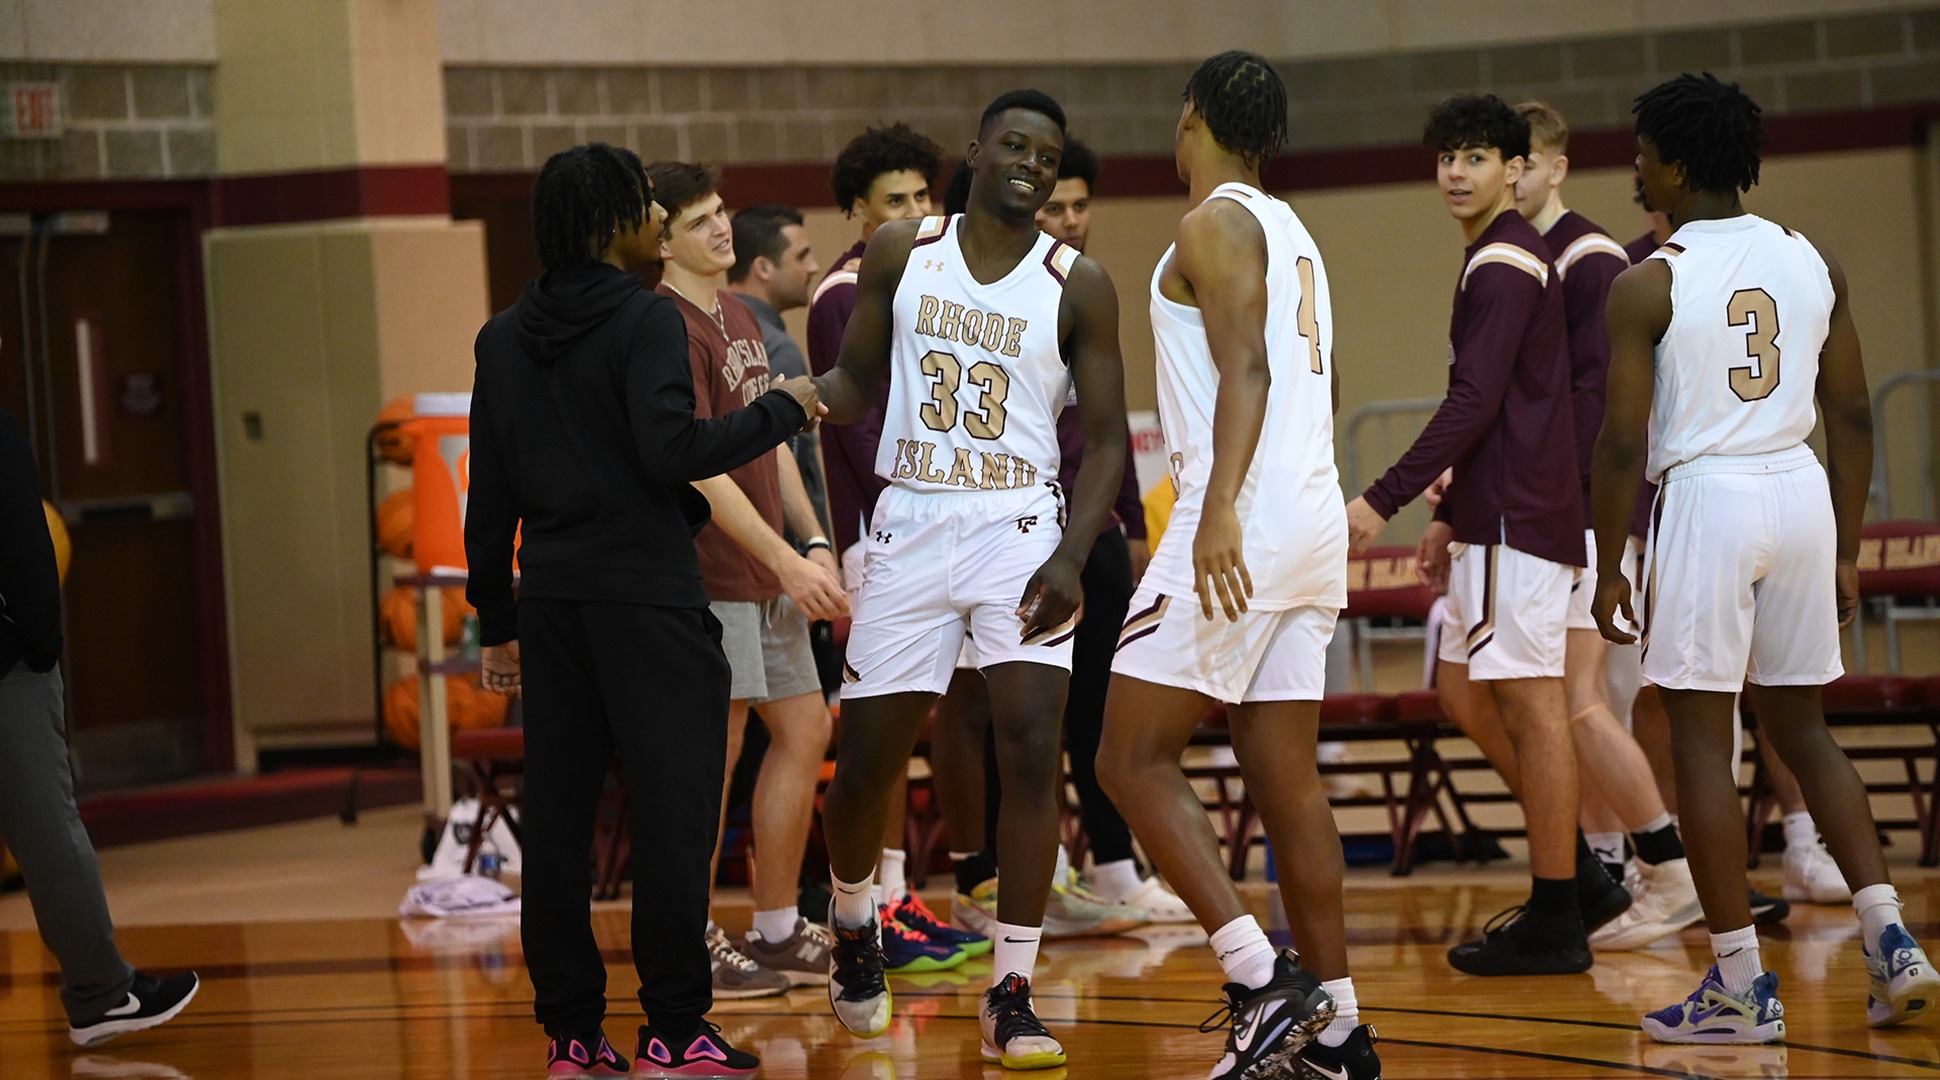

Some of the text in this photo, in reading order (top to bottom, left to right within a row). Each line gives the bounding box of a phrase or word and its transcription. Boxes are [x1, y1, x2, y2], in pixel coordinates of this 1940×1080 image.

[915, 294, 1028, 358] RHODE
[1296, 256, 1323, 375] 4
[1726, 287, 1781, 402] 3
[920, 349, 1010, 440] 33
[891, 439, 1037, 490] ISLAND
